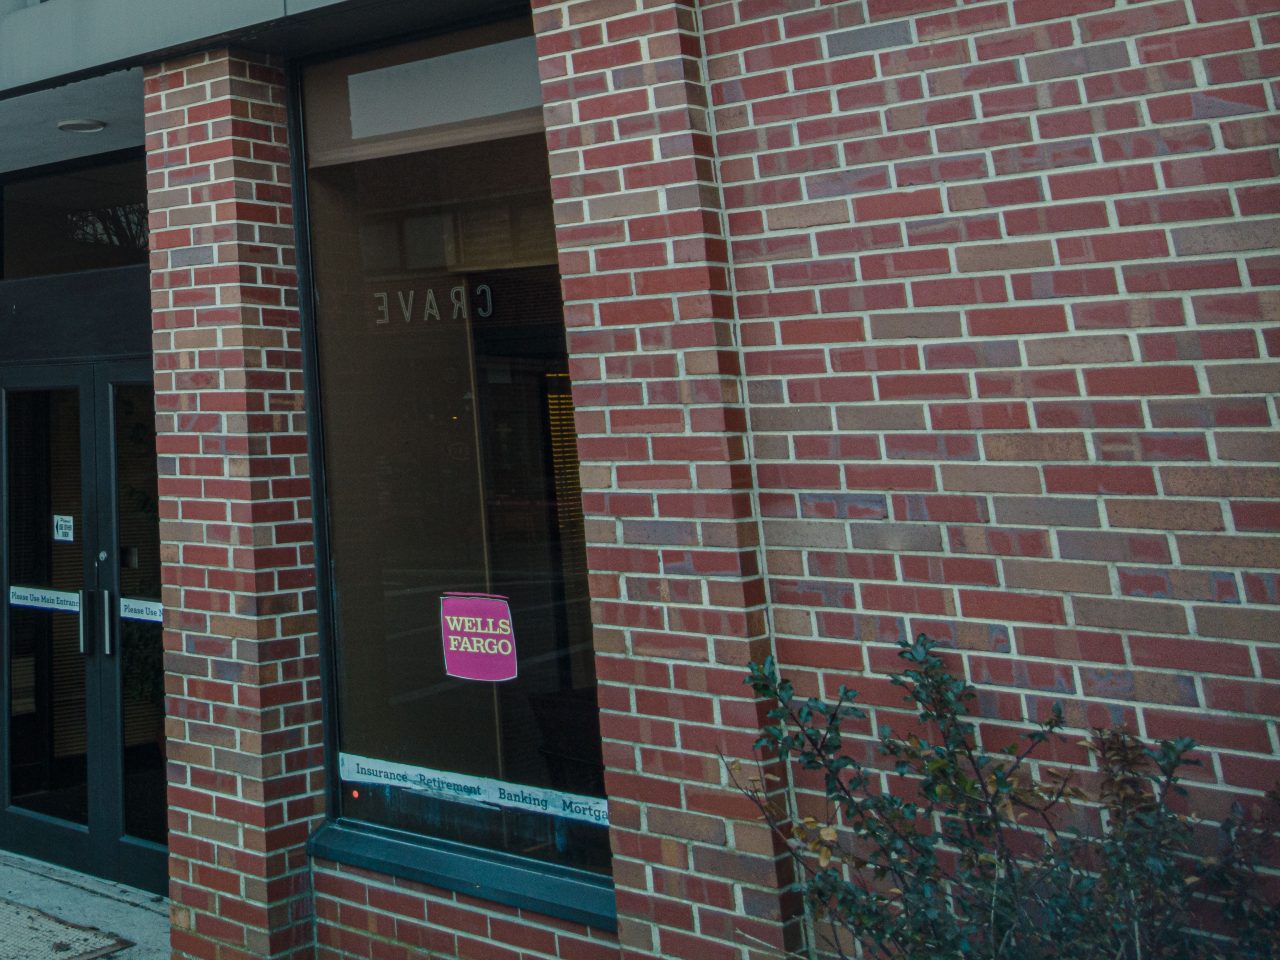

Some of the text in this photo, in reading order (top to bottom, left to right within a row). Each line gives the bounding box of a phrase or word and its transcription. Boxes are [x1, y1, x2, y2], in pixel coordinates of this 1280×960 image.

[11, 591, 29, 601] Please
[29, 594, 40, 602] Use
[40, 594, 56, 605] Main
[123, 603, 144, 615] Please
[145, 606, 158, 617] Use
[444, 616, 511, 635] WELLS
[448, 635, 512, 655] FARGO
[356, 763, 408, 783] Insurance
[419, 773, 482, 797] Retirement
[498, 788, 548, 810] Banking
